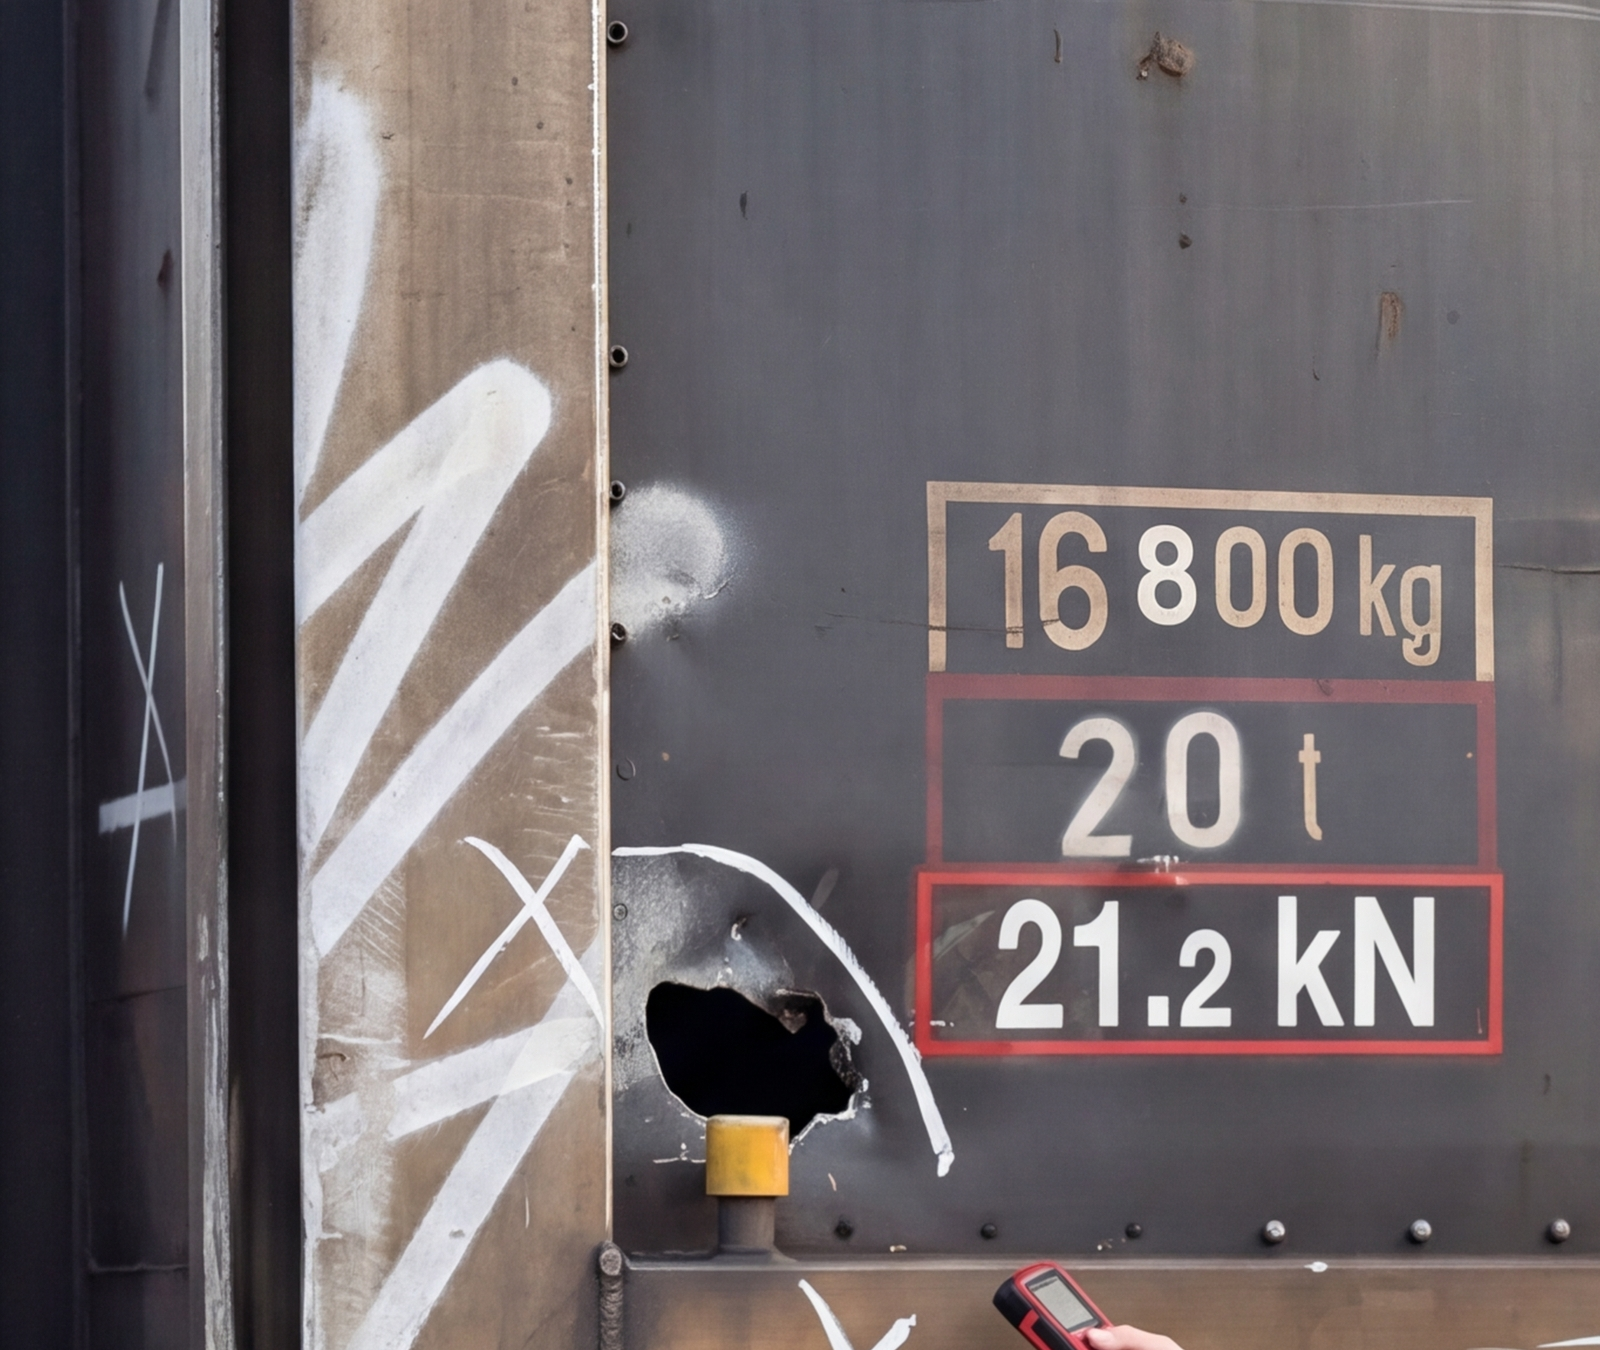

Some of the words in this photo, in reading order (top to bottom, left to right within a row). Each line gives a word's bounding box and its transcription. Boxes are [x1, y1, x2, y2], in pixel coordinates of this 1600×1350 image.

[988, 511, 1108, 651] 16
[1137, 524, 1334, 636] 800
[1359, 534, 1442, 667] kg
[1058, 711, 1243, 858] 20
[1298, 733, 1322, 840] t
[995, 898, 1232, 1029] 21.2
[1277, 896, 1435, 1027] kN
